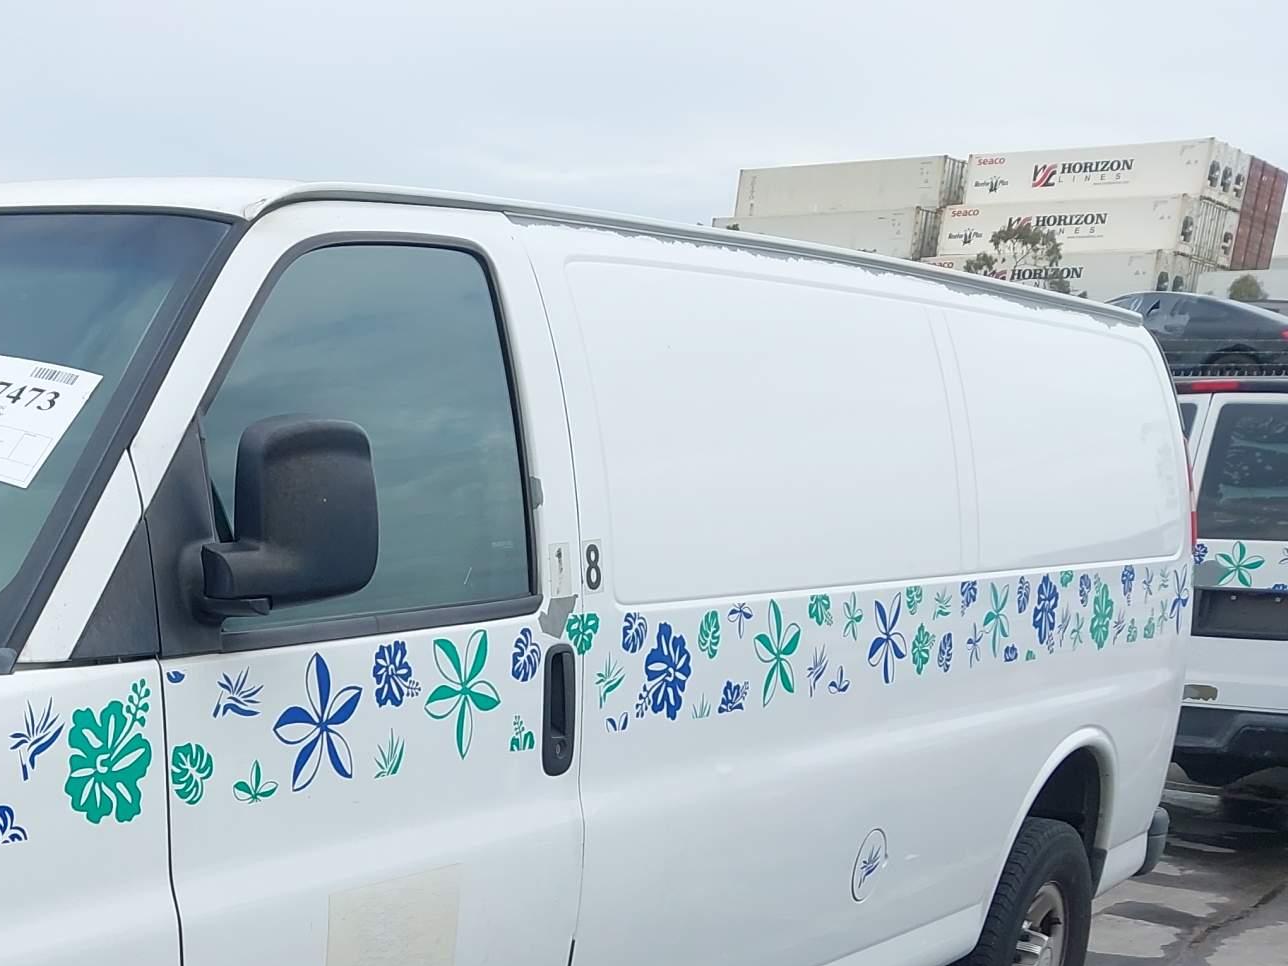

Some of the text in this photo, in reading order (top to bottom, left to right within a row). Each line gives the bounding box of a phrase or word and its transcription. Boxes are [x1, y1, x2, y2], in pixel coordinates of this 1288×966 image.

[977, 157, 1005, 166] seaco
[1061, 158, 1135, 174] HORIZON
[1059, 173, 1121, 183] LINES
[951, 209, 979, 217] seaco
[1035, 213, 1108, 227] HORIZON
[1010, 267, 1084, 281] HORIZON
[586, 544, 601, 590] 8
